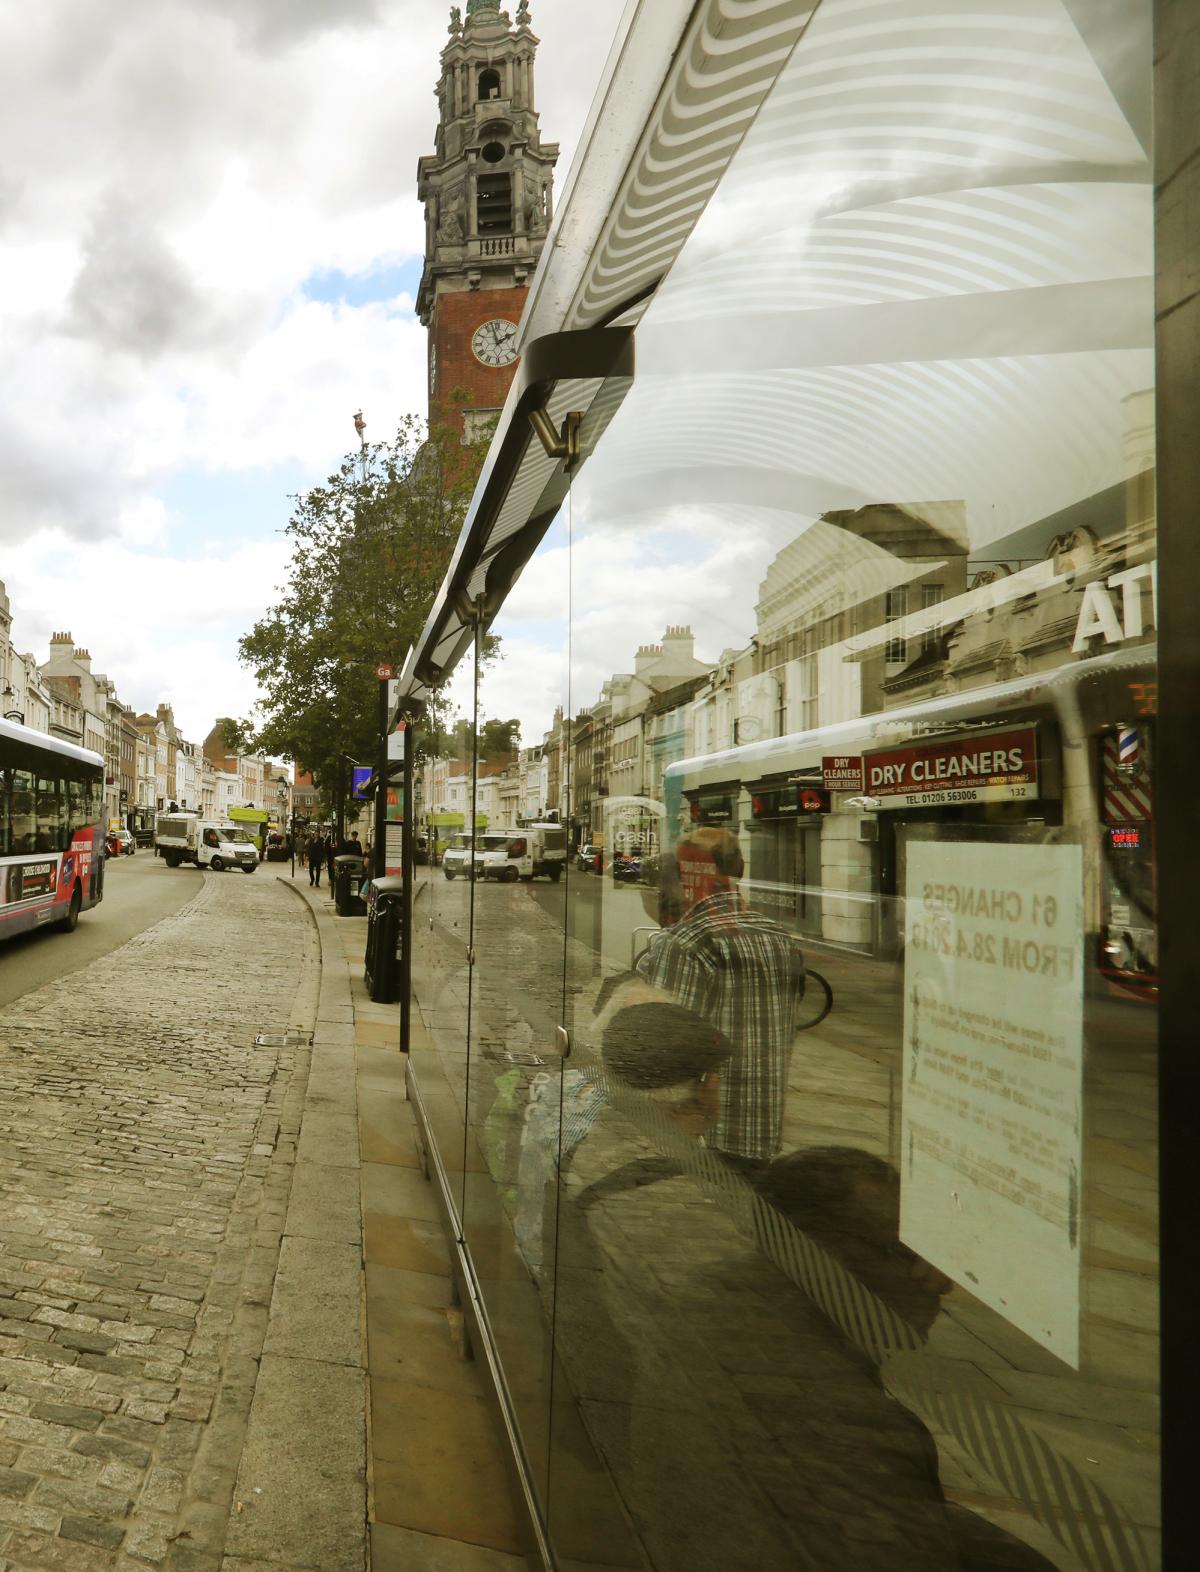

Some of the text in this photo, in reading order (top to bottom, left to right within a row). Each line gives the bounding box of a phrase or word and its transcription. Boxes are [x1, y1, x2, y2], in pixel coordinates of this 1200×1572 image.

[377, 667, 391, 676] Ga
[834, 758, 850, 768] DRY
[871, 748, 1024, 786] DRY CLEANERS
[823, 769, 861, 779] CLEANERS
[906, 790, 977, 804] TEL: 01206 563006
[1010, 788, 1026, 797] 132
[804, 801, 821, 809] pop
[615, 829, 657, 843] cash
